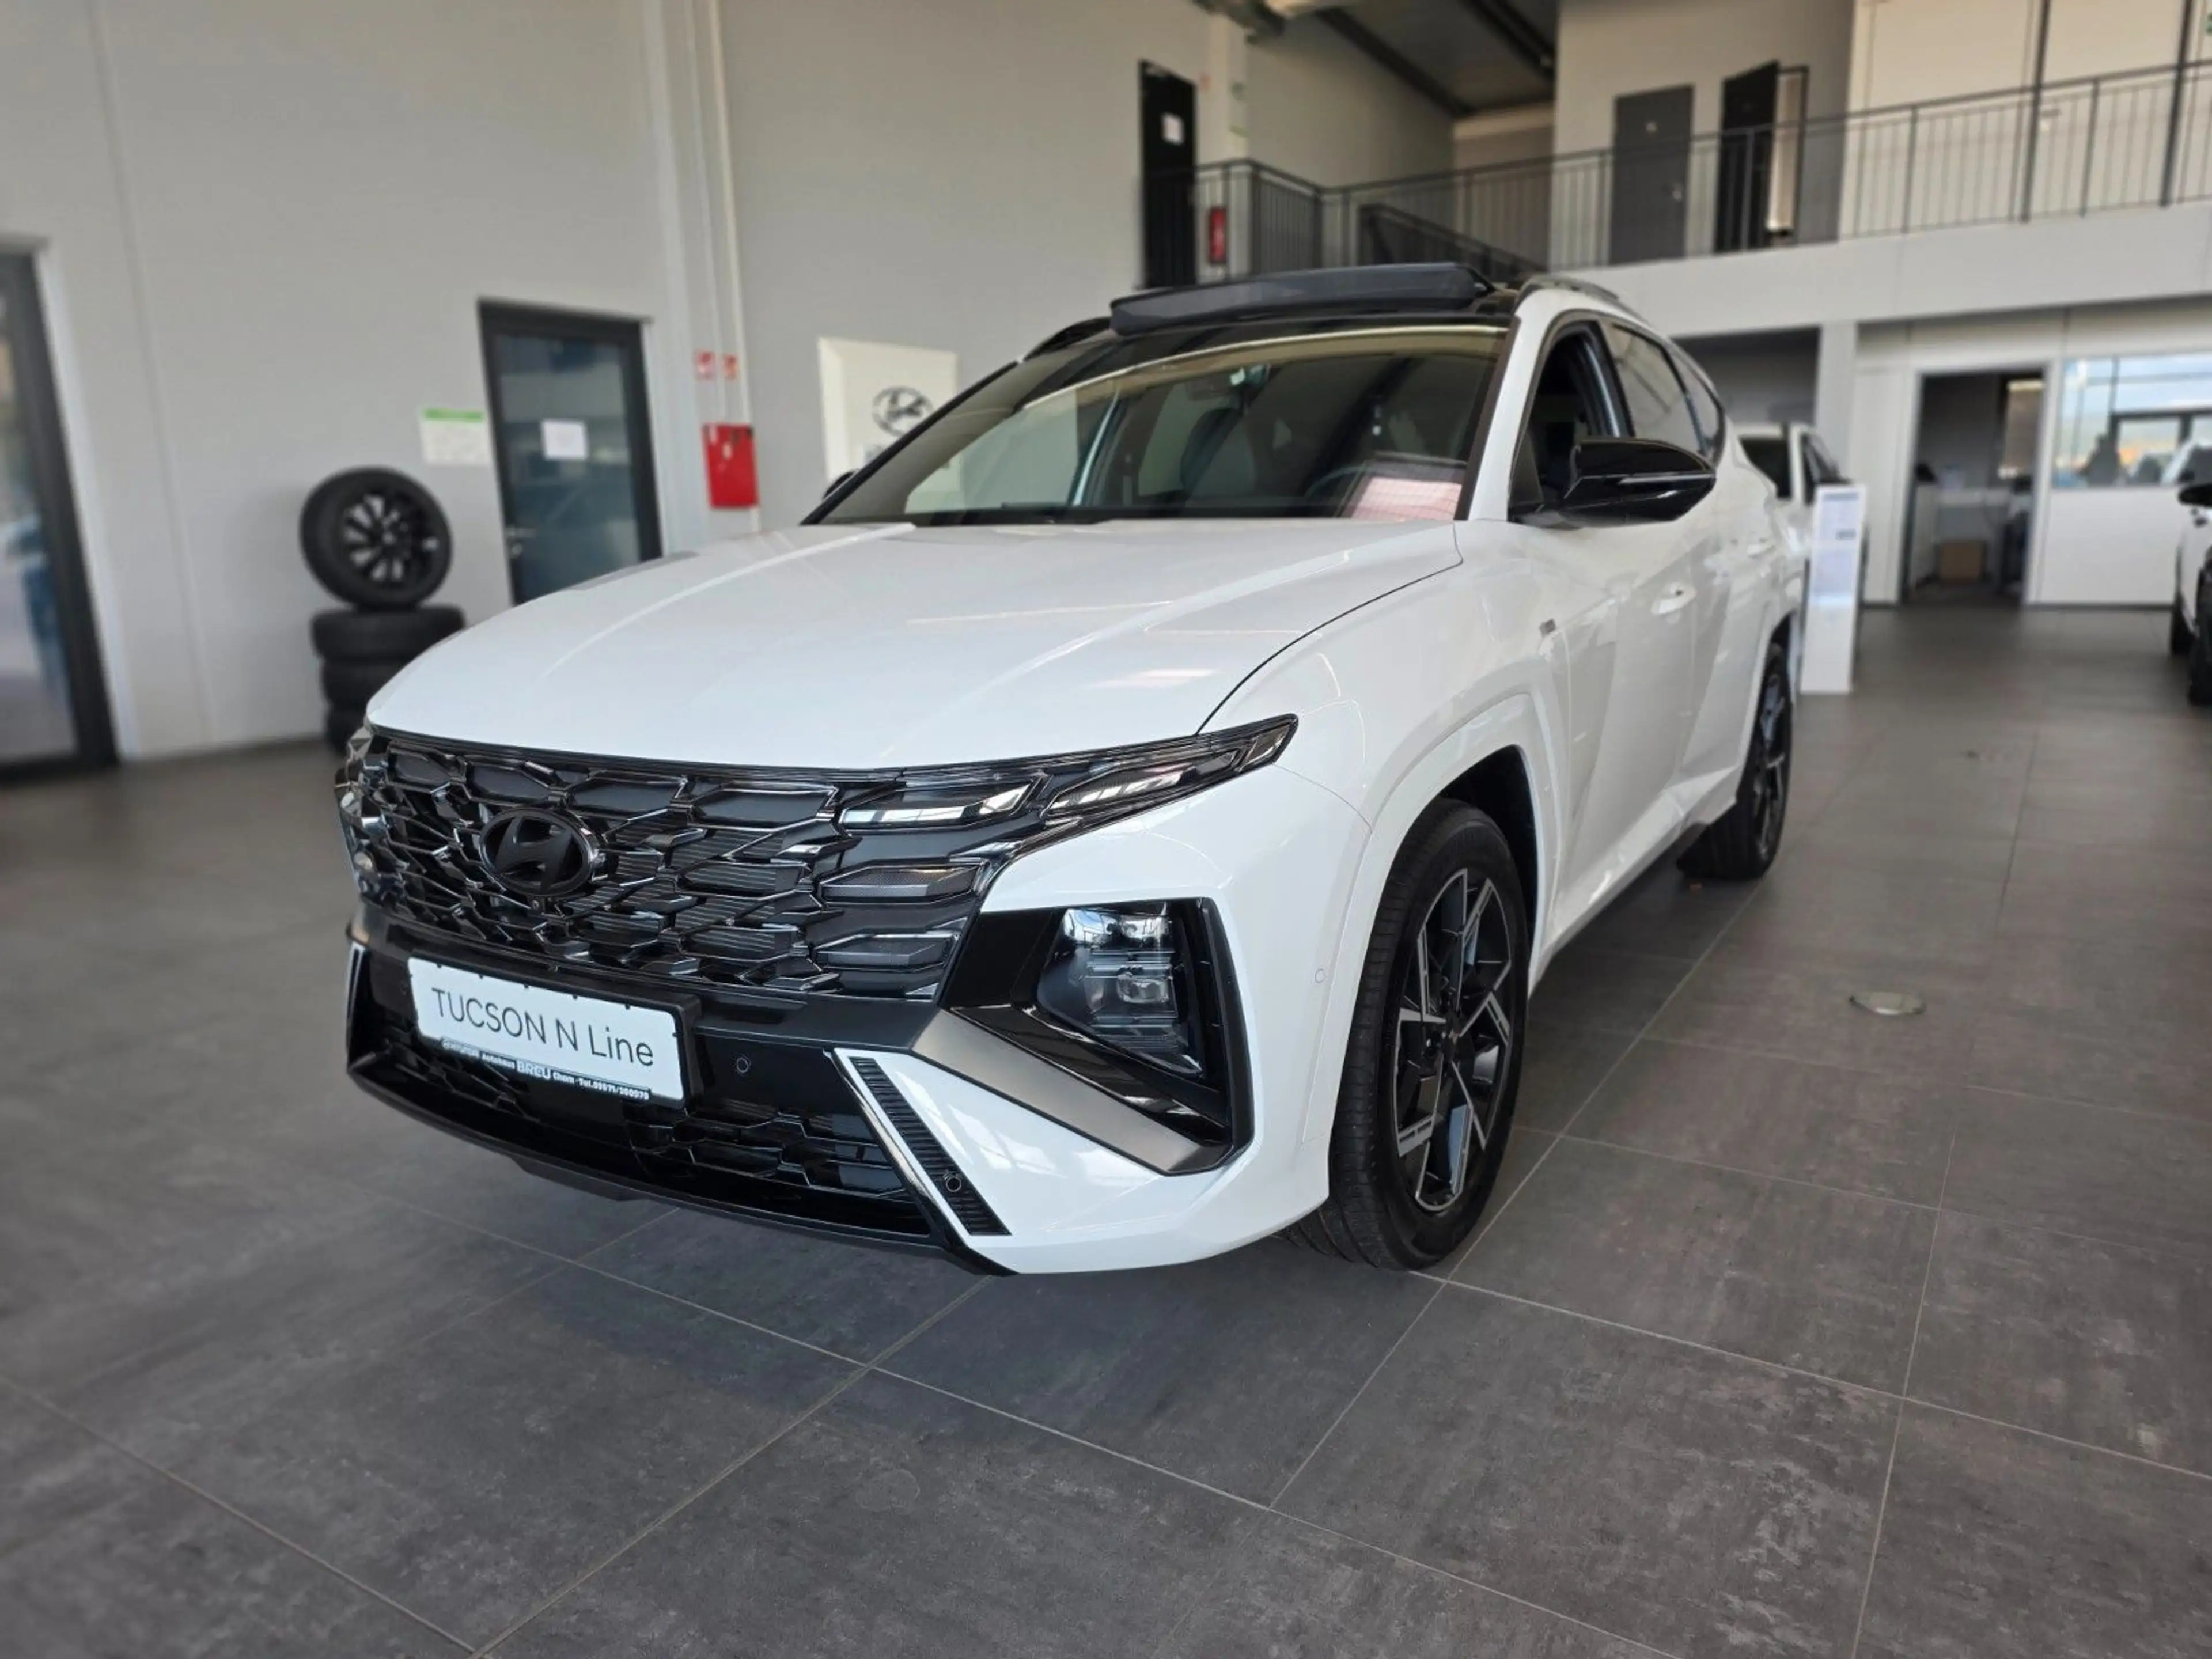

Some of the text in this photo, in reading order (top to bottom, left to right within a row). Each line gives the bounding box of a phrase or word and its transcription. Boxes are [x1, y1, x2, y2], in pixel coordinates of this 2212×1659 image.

[431, 987, 654, 1067] TUCSON N Line
